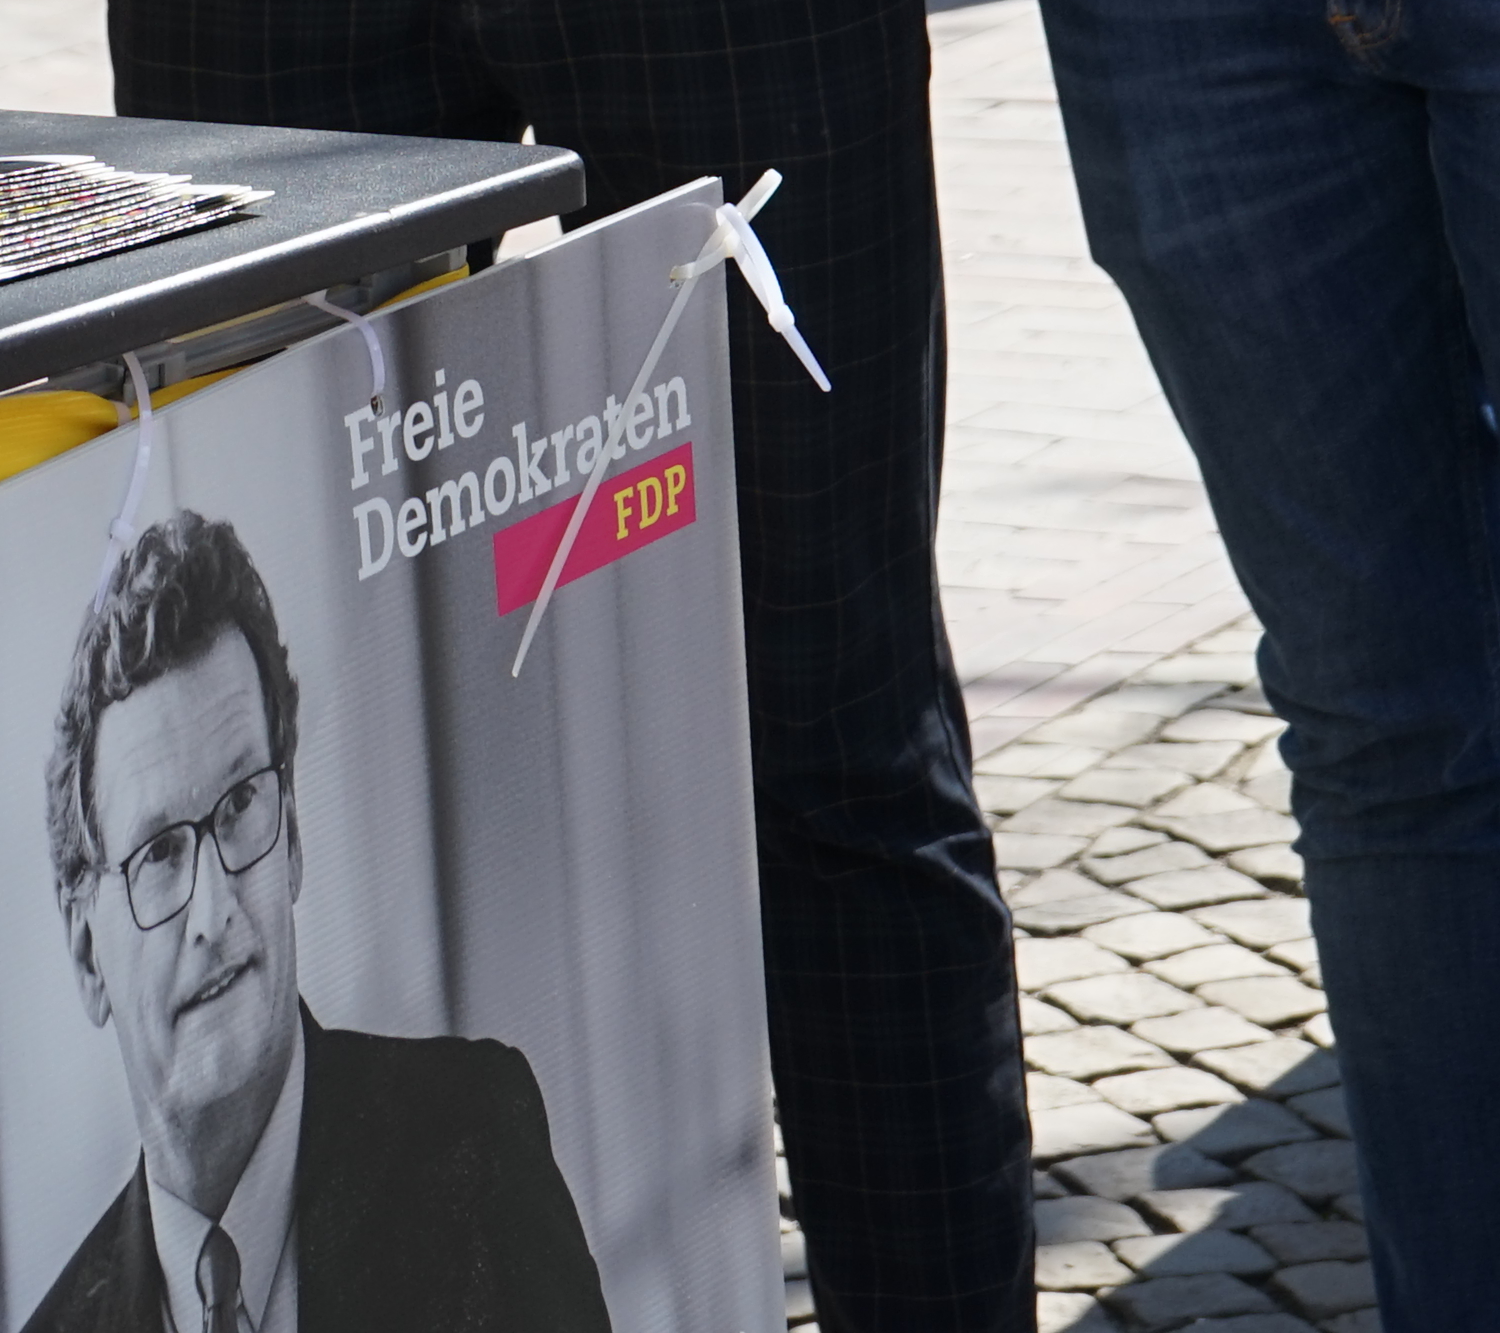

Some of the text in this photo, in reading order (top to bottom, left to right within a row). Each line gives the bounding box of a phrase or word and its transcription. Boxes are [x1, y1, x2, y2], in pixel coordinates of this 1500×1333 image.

[344, 368, 486, 491] Freie
[352, 375, 694, 582] Demokraten
[613, 464, 687, 541] FDP
